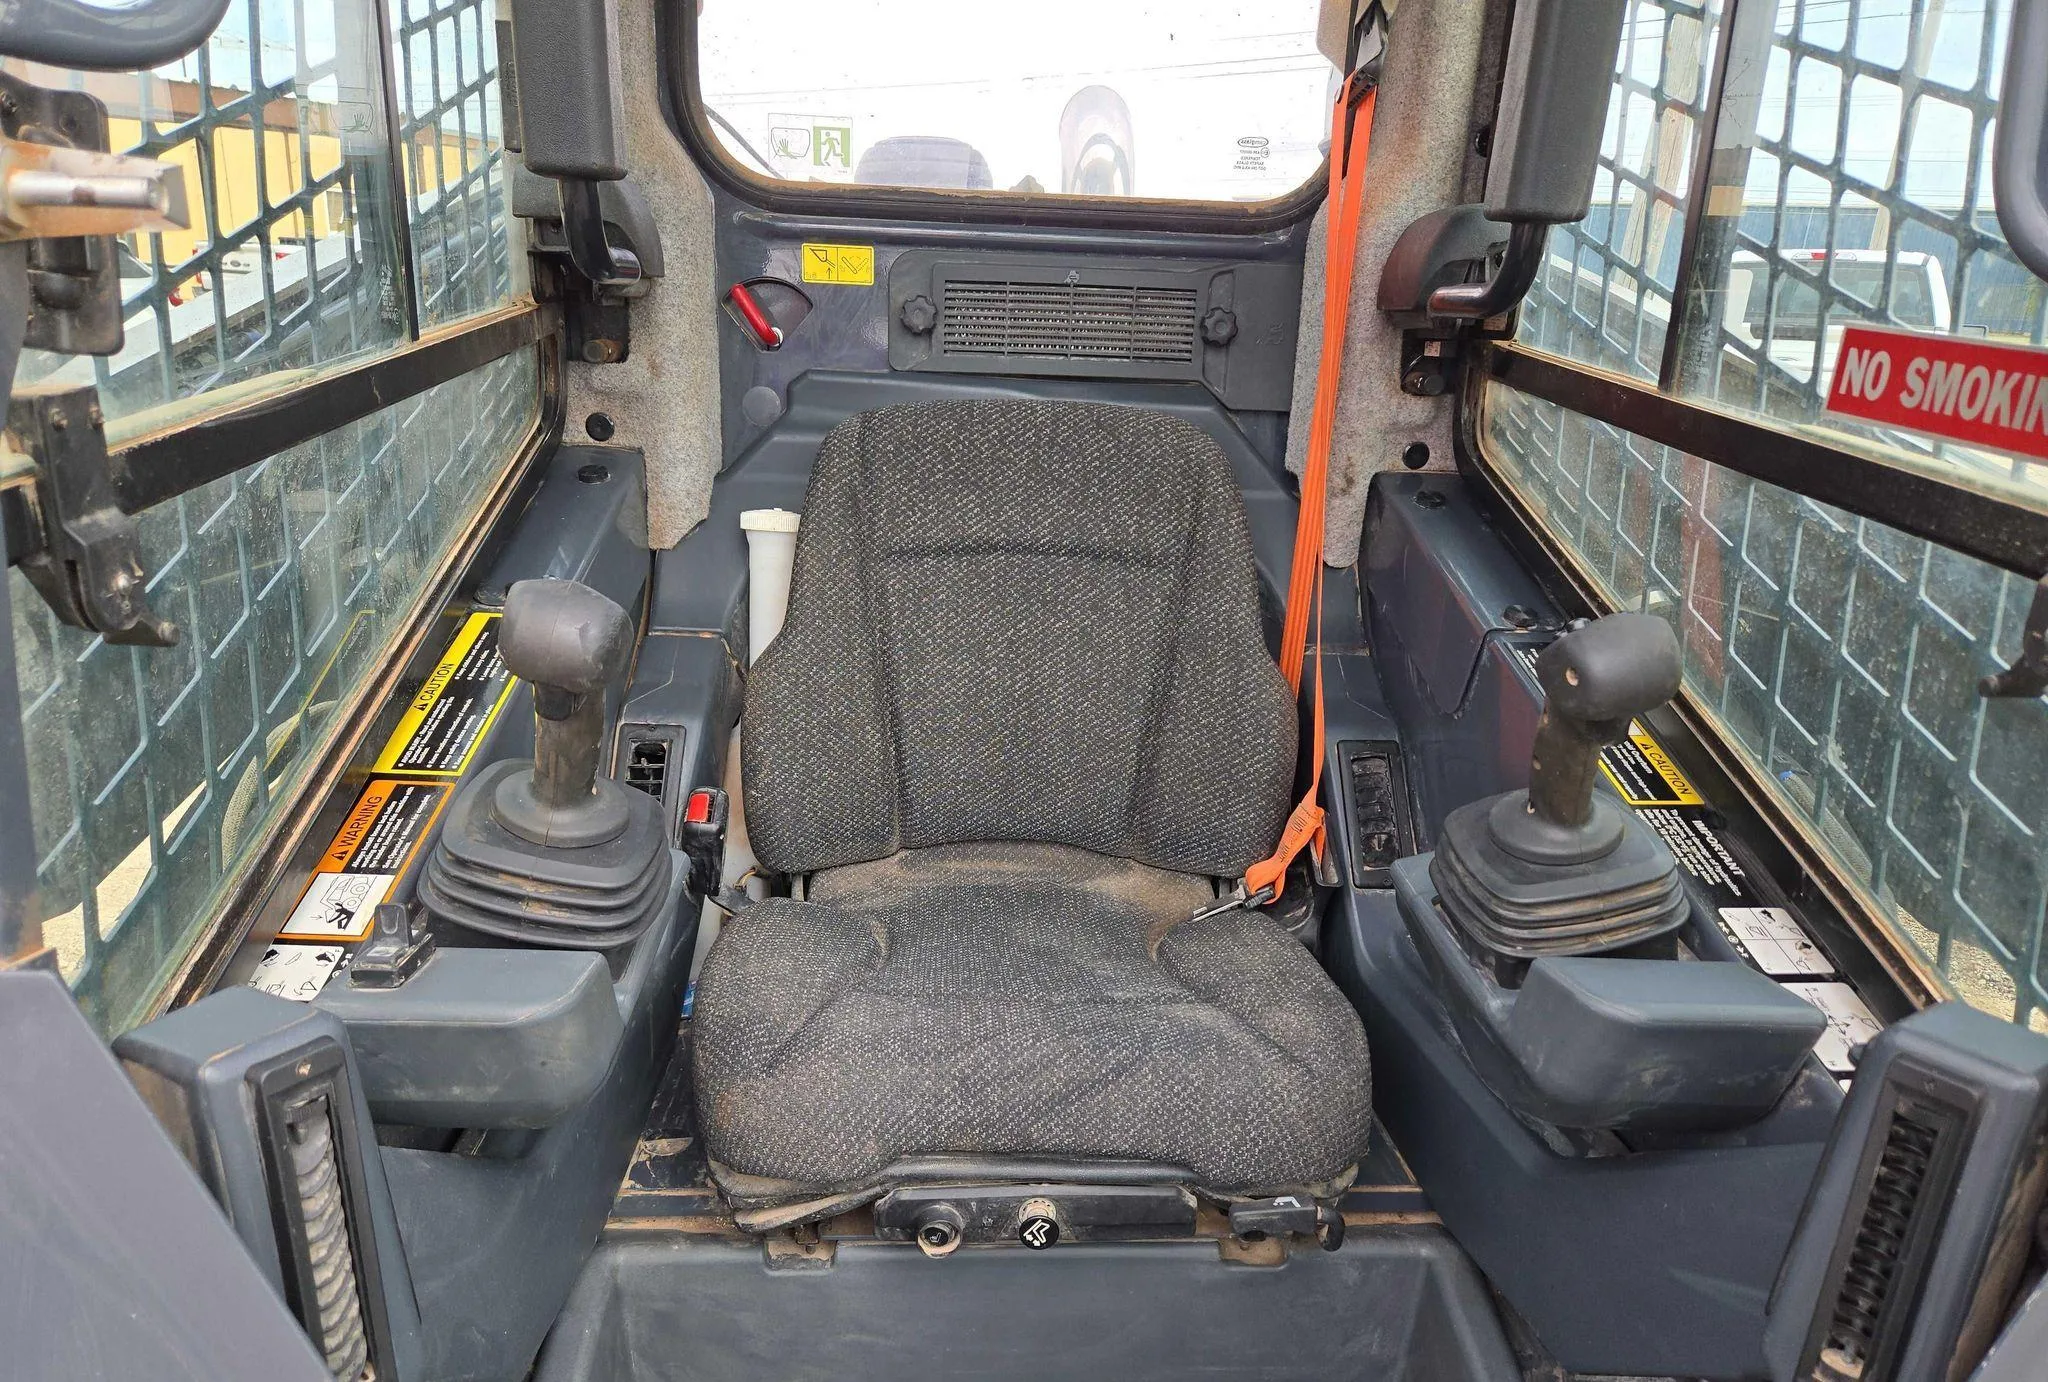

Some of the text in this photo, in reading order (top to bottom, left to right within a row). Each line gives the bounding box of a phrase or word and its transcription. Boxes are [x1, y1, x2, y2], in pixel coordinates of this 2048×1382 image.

[1839, 347, 2048, 436] NO SMOKIN
[420, 663, 454, 700] CAUTION
[1650, 752, 1692, 794] CAUTION
[338, 796, 382, 846] WARNING
[352, 801, 397, 868] Always install boom lock before
[361, 850, 377, 868] working
[380, 822, 393, 837] around
[395, 796, 409, 813] machine
[406, 787, 414, 796] with
[374, 846, 386, 860] loader
[382, 832, 395, 845] boom
[382, 860, 392, 868] See
[388, 836, 406, 859] Operator's
[402, 820, 415, 836] Manual
[1674, 816, 1695, 836] prevent
[1692, 837, 1711, 858] damage
[1714, 866, 1741, 896] hydraulics
[1690, 846, 1721, 883] temperatures
[1692, 820, 1745, 877] IMPORTANT
